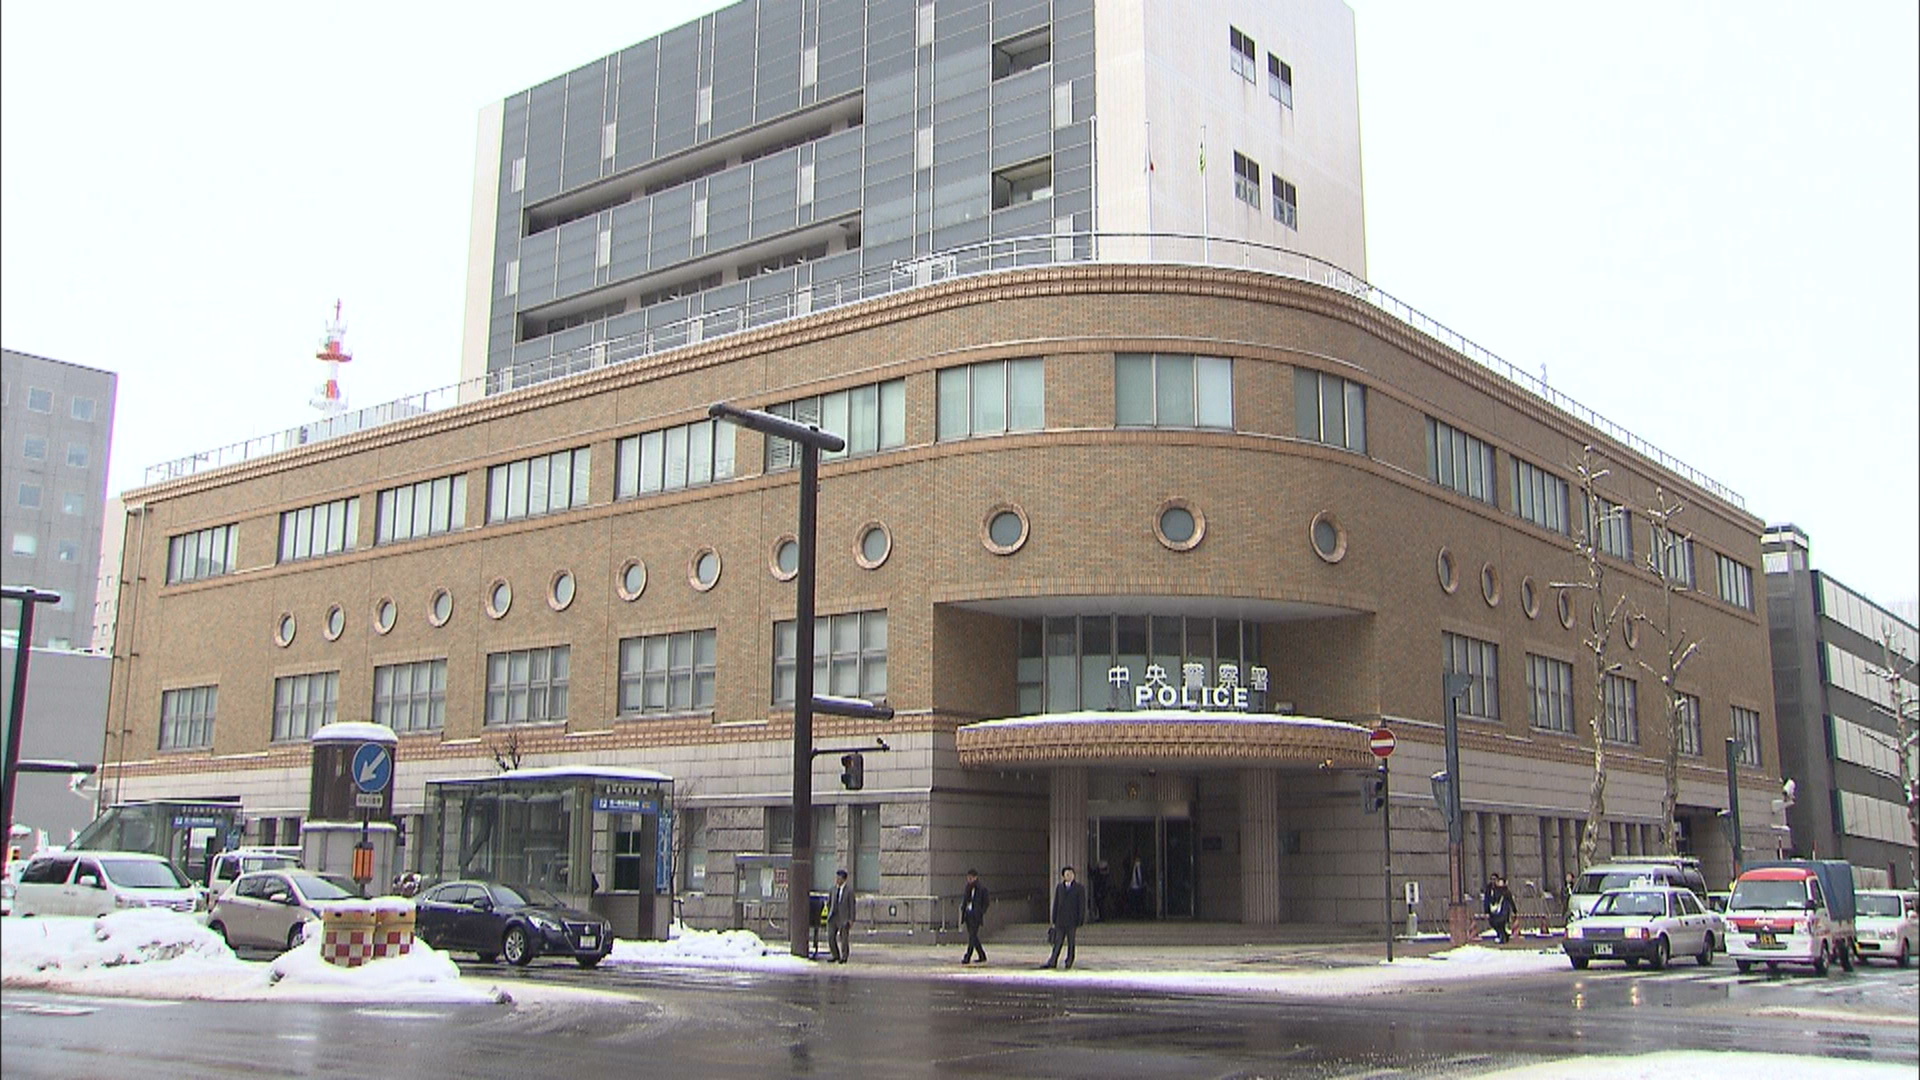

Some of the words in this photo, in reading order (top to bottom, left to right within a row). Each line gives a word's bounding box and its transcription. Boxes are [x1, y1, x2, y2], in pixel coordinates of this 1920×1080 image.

[1108, 662, 1268, 691] 中央警察署
[1135, 686, 1249, 708] POLICE
